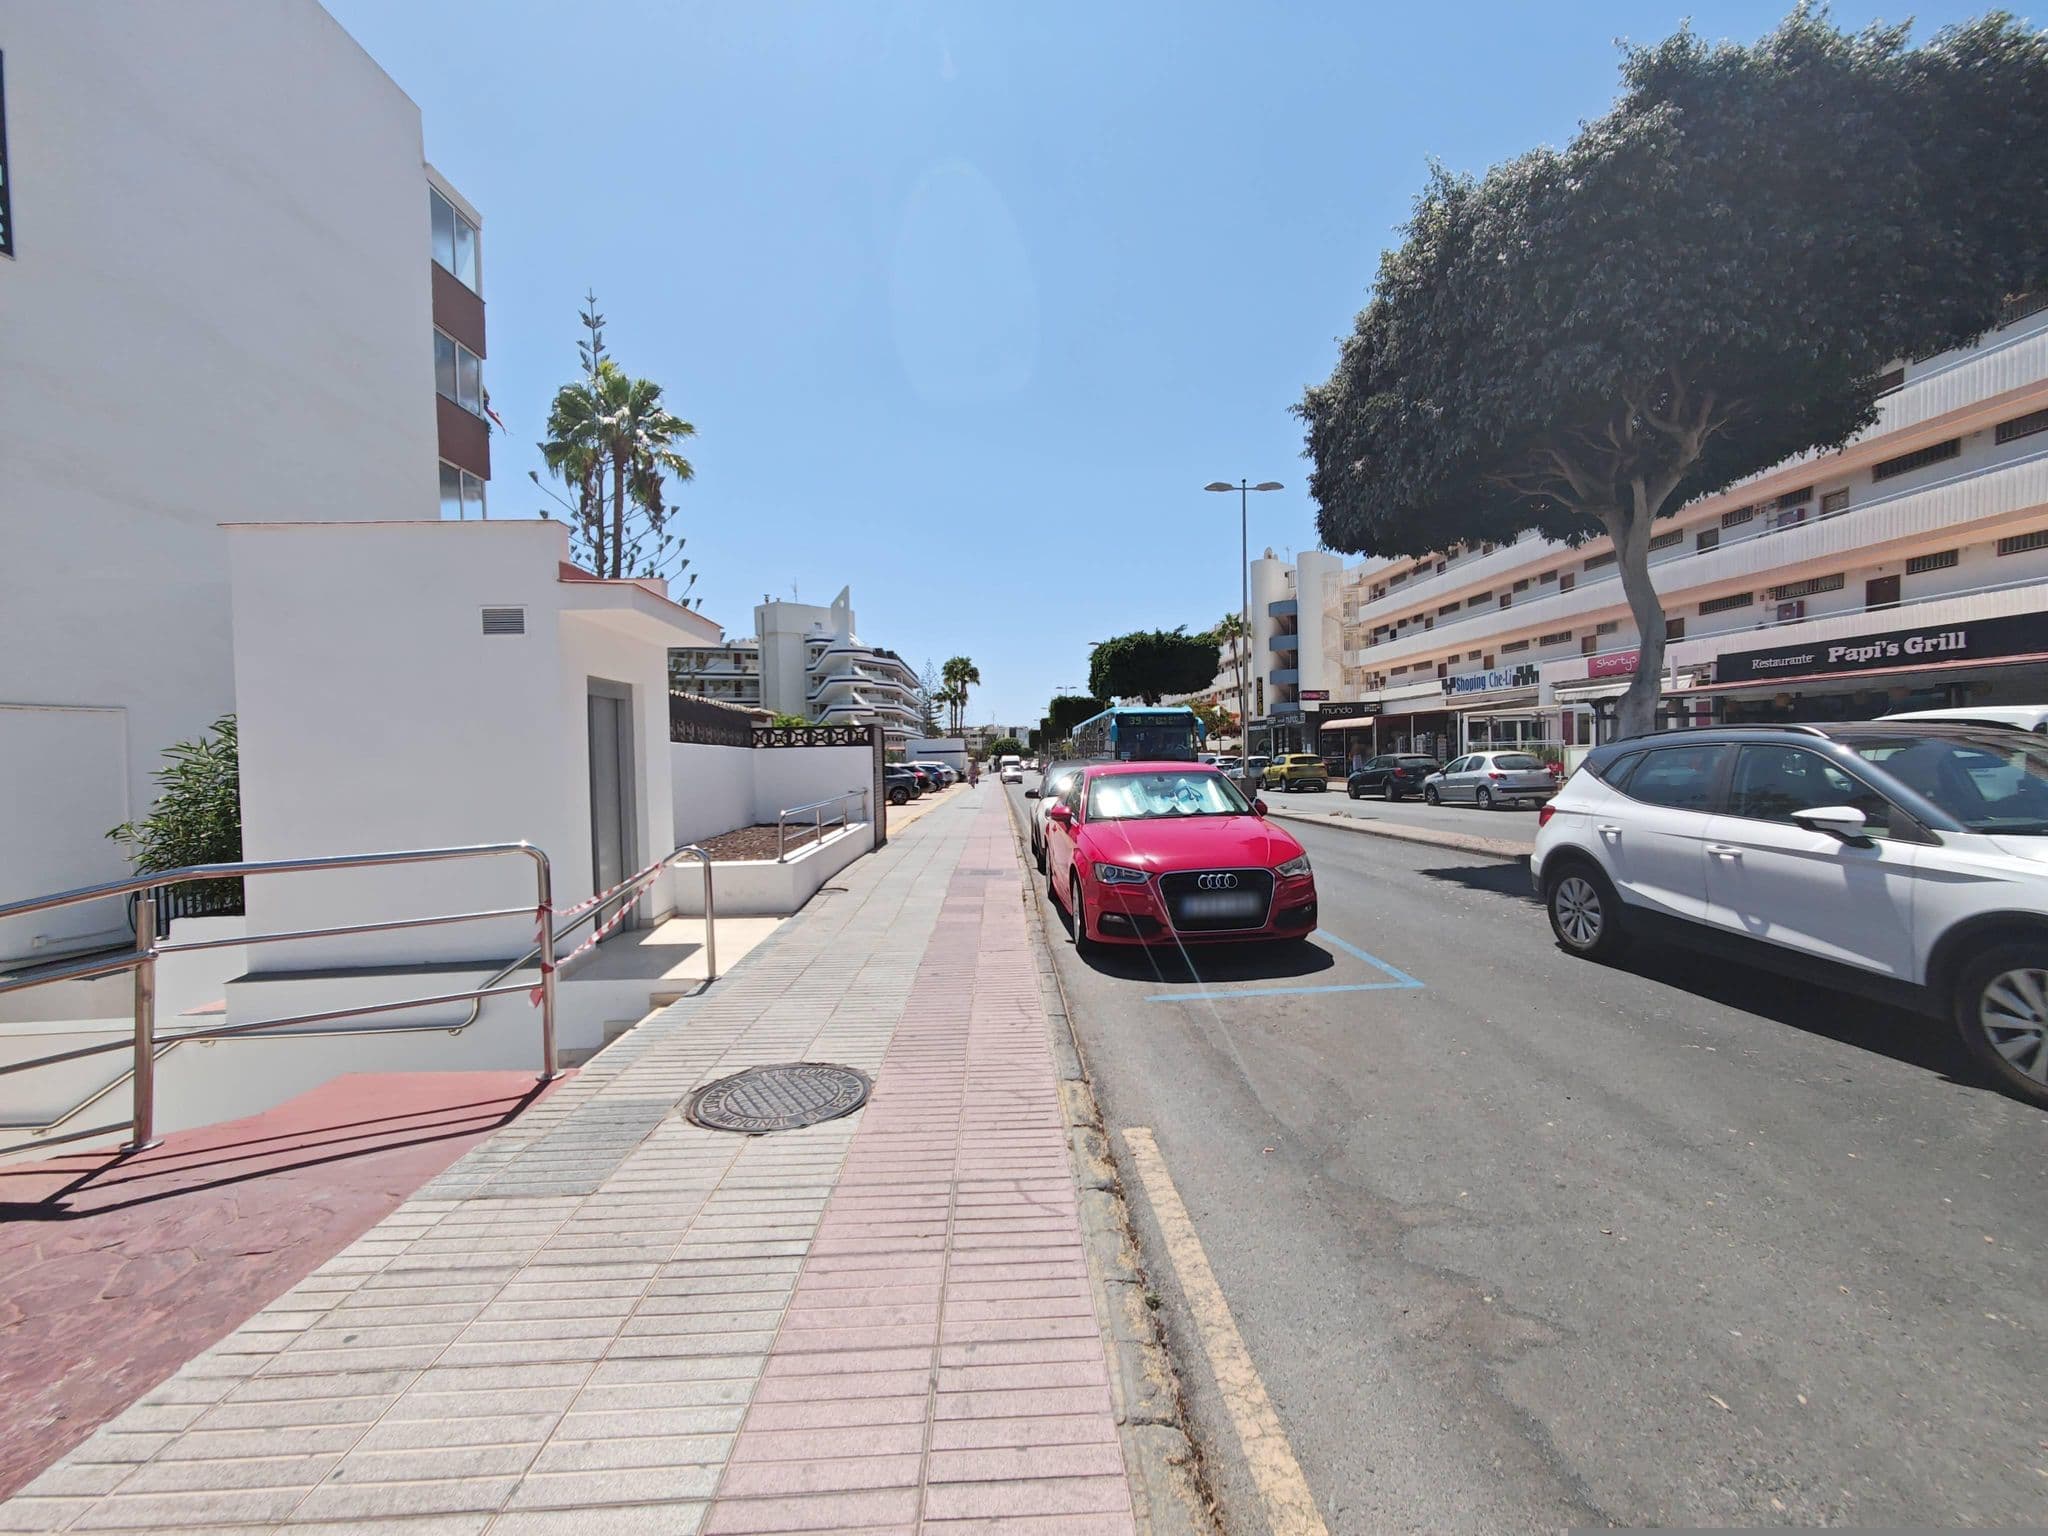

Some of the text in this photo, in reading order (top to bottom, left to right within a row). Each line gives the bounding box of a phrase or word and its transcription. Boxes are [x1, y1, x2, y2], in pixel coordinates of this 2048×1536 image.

[1751, 631, 1967, 670] Restaurante Papi's Grill
[1596, 655, 1639, 672] Shortys
[1456, 670, 1512, 692] Shoping Che-Li
[1322, 705, 1353, 715] mundo
